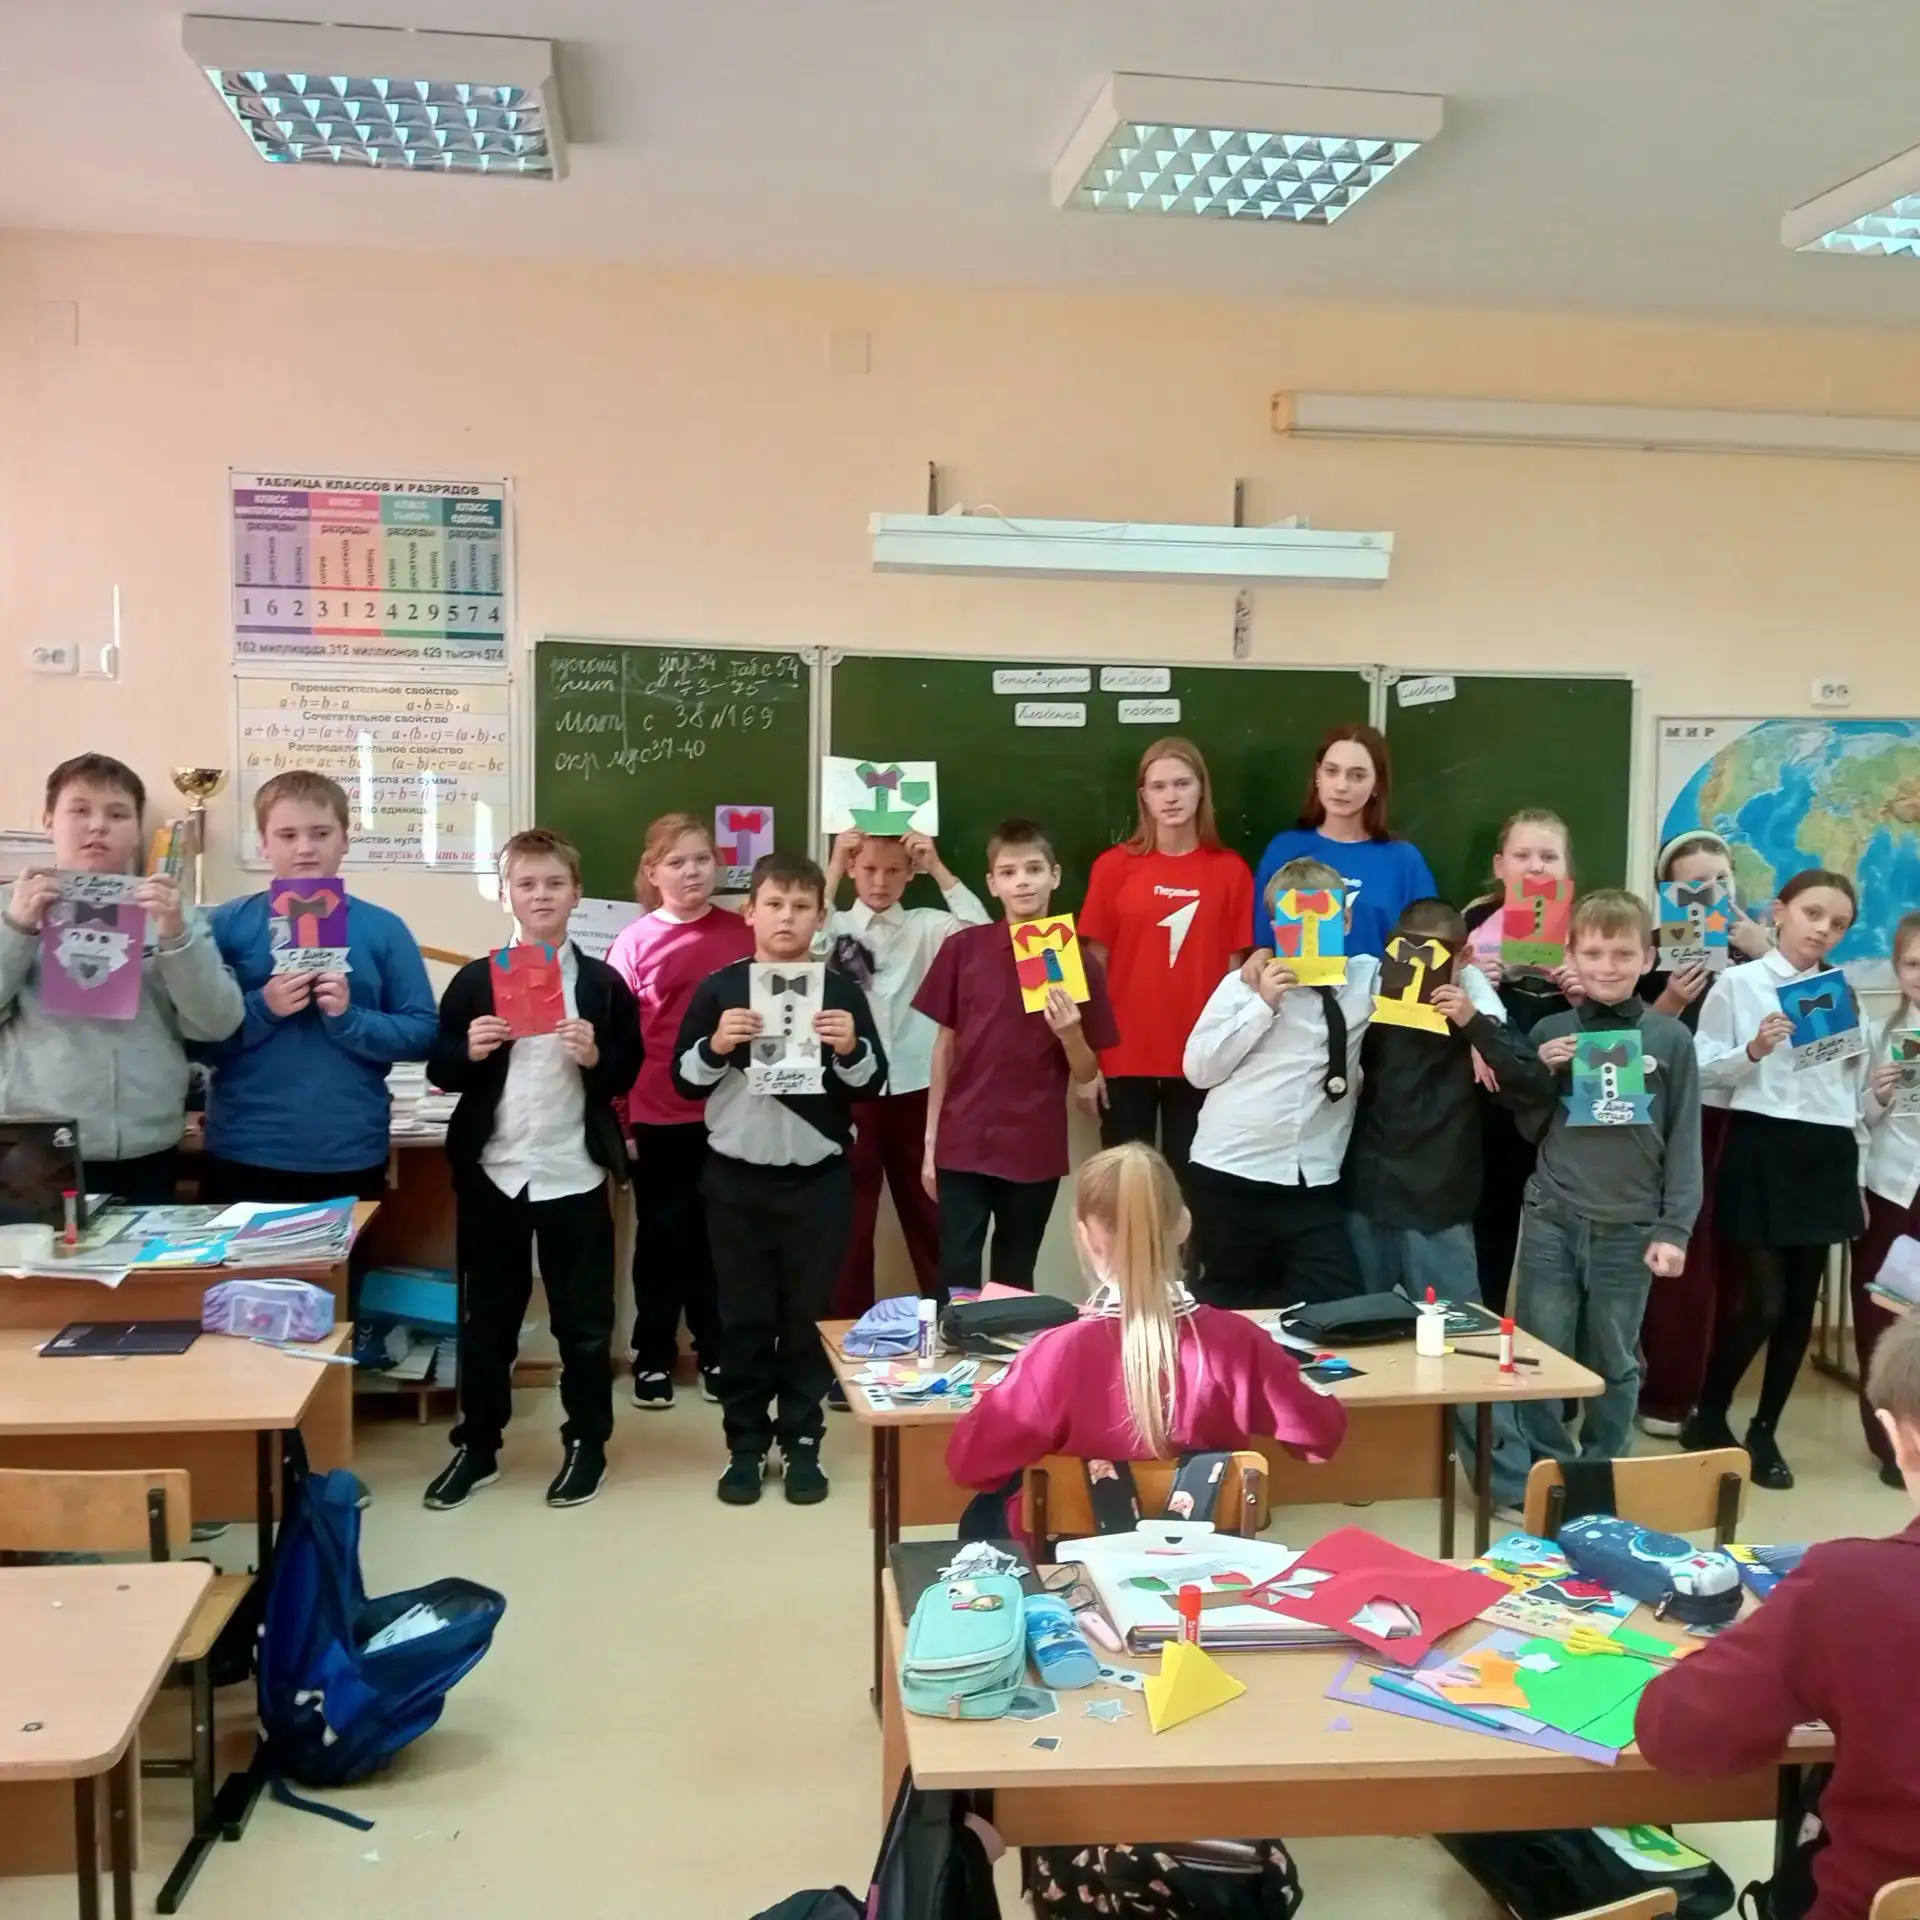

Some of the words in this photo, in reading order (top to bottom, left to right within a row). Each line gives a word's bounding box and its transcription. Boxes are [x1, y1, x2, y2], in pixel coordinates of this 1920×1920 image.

[256, 477, 322, 488] ТАБЛИЦА
[326, 480, 391, 491] КЛАССОВ
[395, 483, 404, 492] И
[408, 484, 480, 495] РАЗРЯДОВ
[243, 598, 251, 615] 1
[267, 599, 278, 616] 6
[293, 600, 304, 616] 2
[317, 600, 328, 618] 3
[342, 602, 349, 618] 1
[364, 602, 375, 618] 2
[386, 603, 398, 619] 4
[407, 604, 418, 620] 2
[427, 604, 440, 621] 9
[447, 605, 459, 622] 5
[467, 605, 479, 622] 7
[488, 606, 500, 622] 4
[290, 682, 402, 696] Переместительное
[405, 686, 460, 696] свойство
[302, 711, 391, 723] Сочетательное
[394, 714, 449, 724] свойство
[409, 745, 465, 755] свойство
